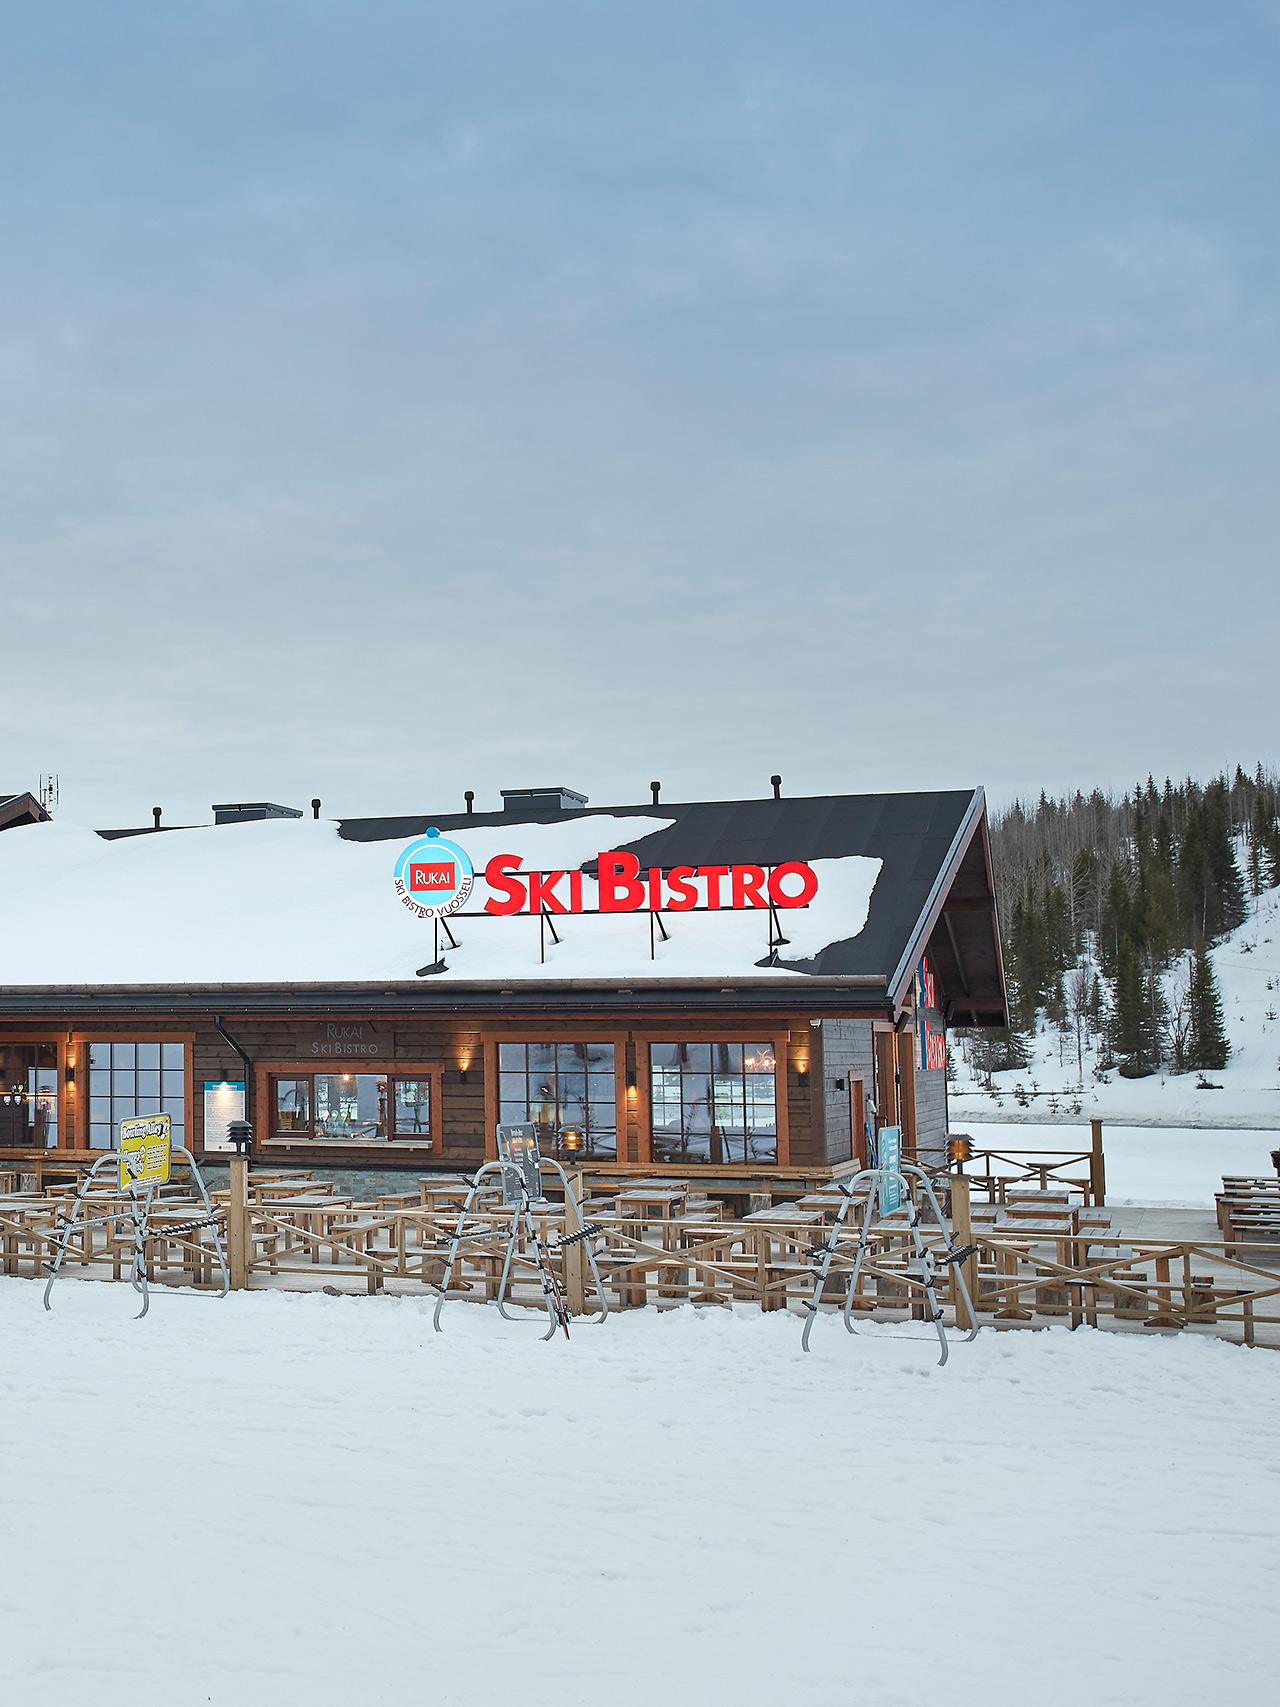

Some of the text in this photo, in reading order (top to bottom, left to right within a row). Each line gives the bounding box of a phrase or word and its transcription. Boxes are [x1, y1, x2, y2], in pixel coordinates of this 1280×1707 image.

[394, 877, 472, 918] SKI BISTRO VUOSSELI
[484, 851, 818, 916] SKI BISTRO
[311, 1041, 378, 1054] SKI BISTRO
[122, 1123, 146, 1140] Bowling
